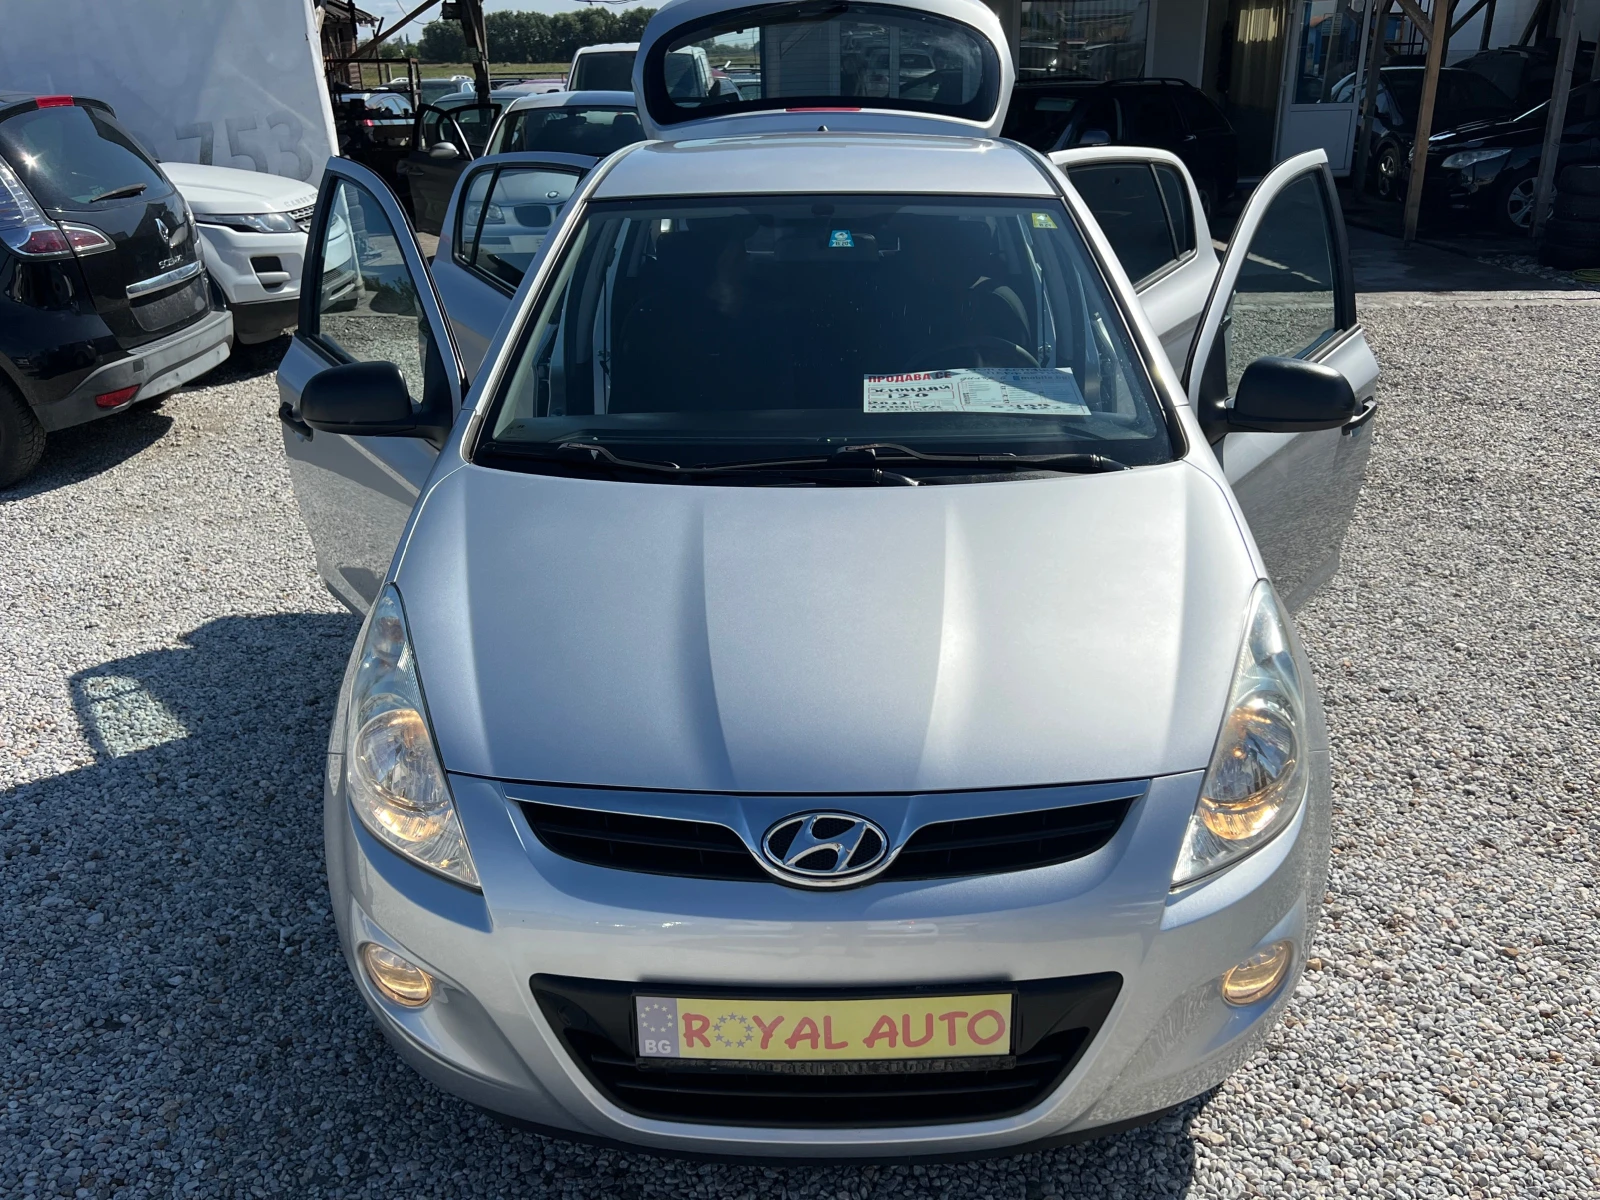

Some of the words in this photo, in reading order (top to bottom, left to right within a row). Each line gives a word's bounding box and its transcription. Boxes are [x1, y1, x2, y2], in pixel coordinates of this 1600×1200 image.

[132, 111, 314, 182] 753
[868, 372, 932, 383] ПРОДАВА
[682, 1012, 848, 1050] ROYAL
[862, 1009, 1006, 1049] AUTO
[644, 1039, 672, 1054] BG
